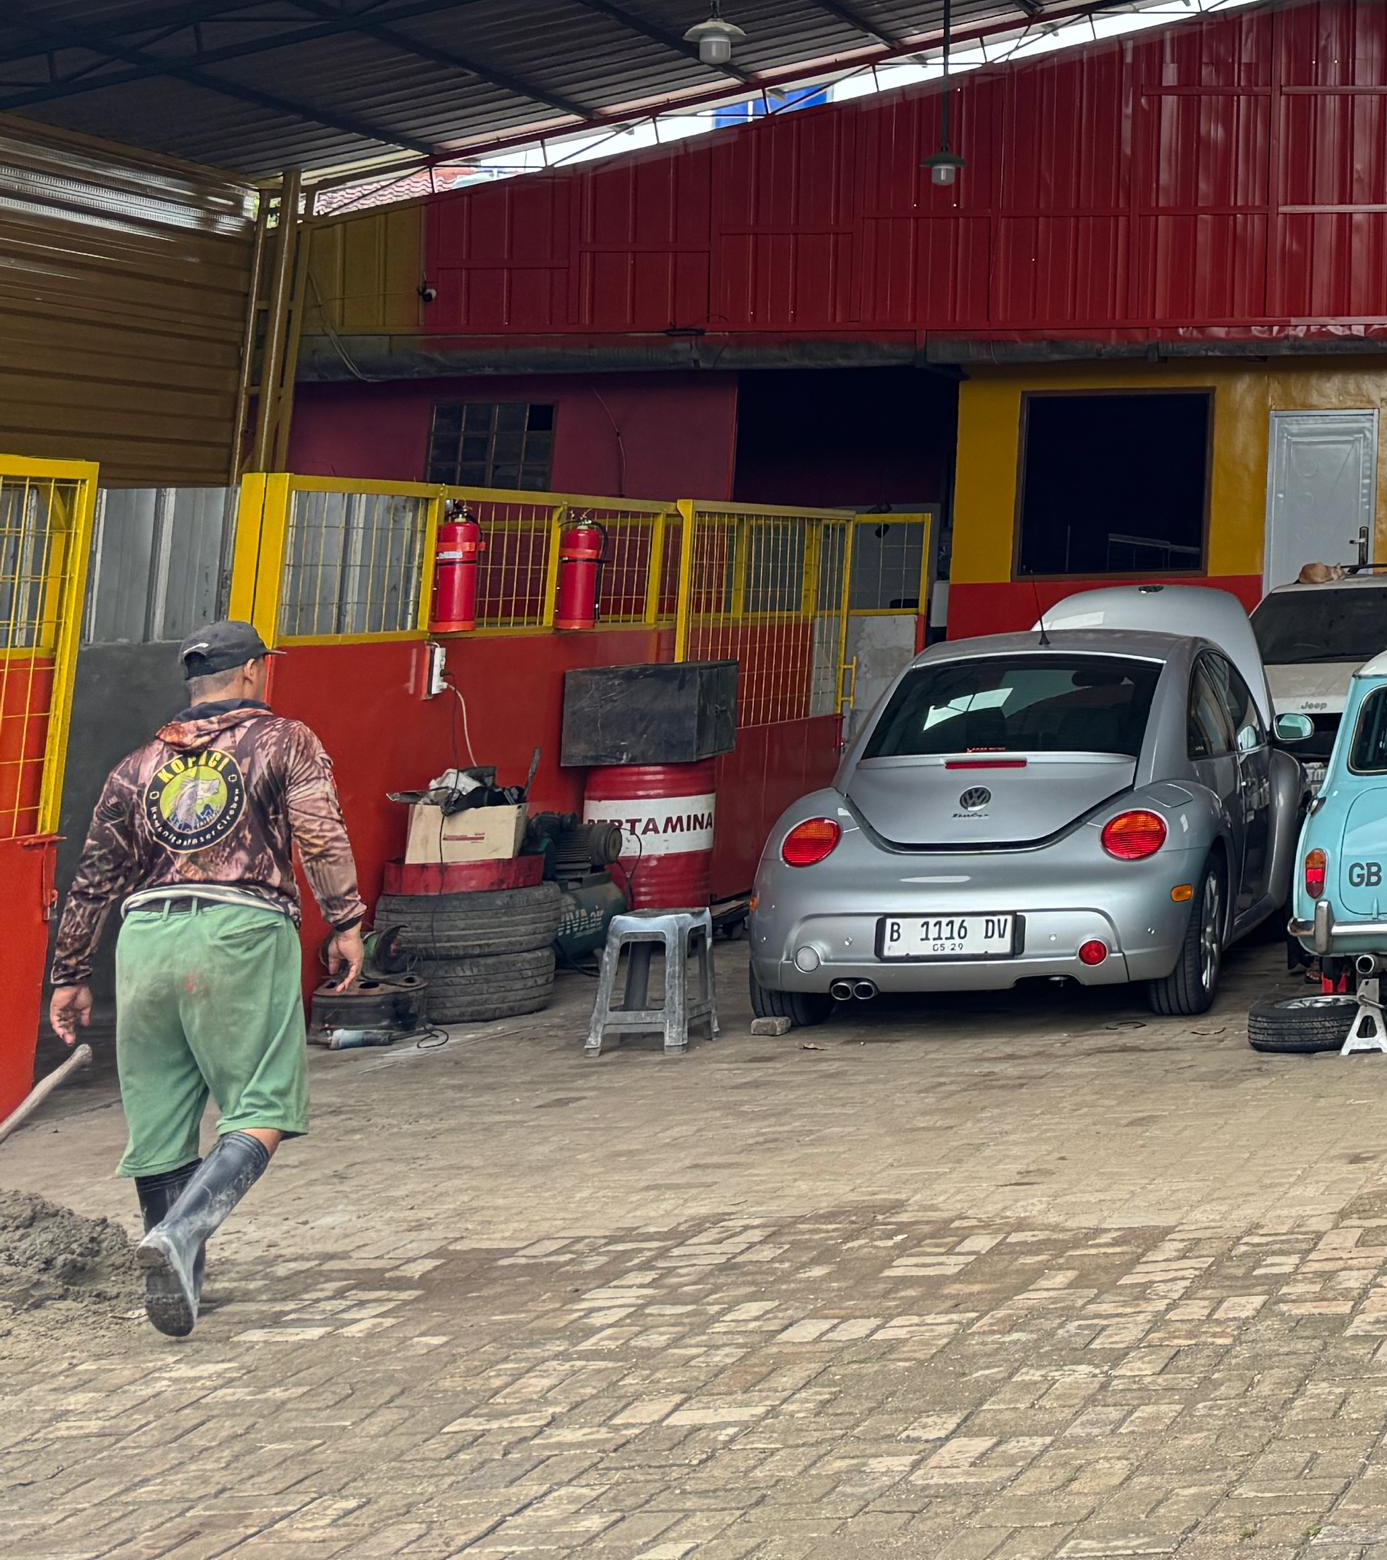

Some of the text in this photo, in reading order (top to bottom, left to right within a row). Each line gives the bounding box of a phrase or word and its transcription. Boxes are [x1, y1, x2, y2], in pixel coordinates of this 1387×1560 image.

[1301, 701, 1327, 711] Jeep
[1348, 862, 1382, 887] GB
[890, 918, 1008, 942] B 1116 DV
